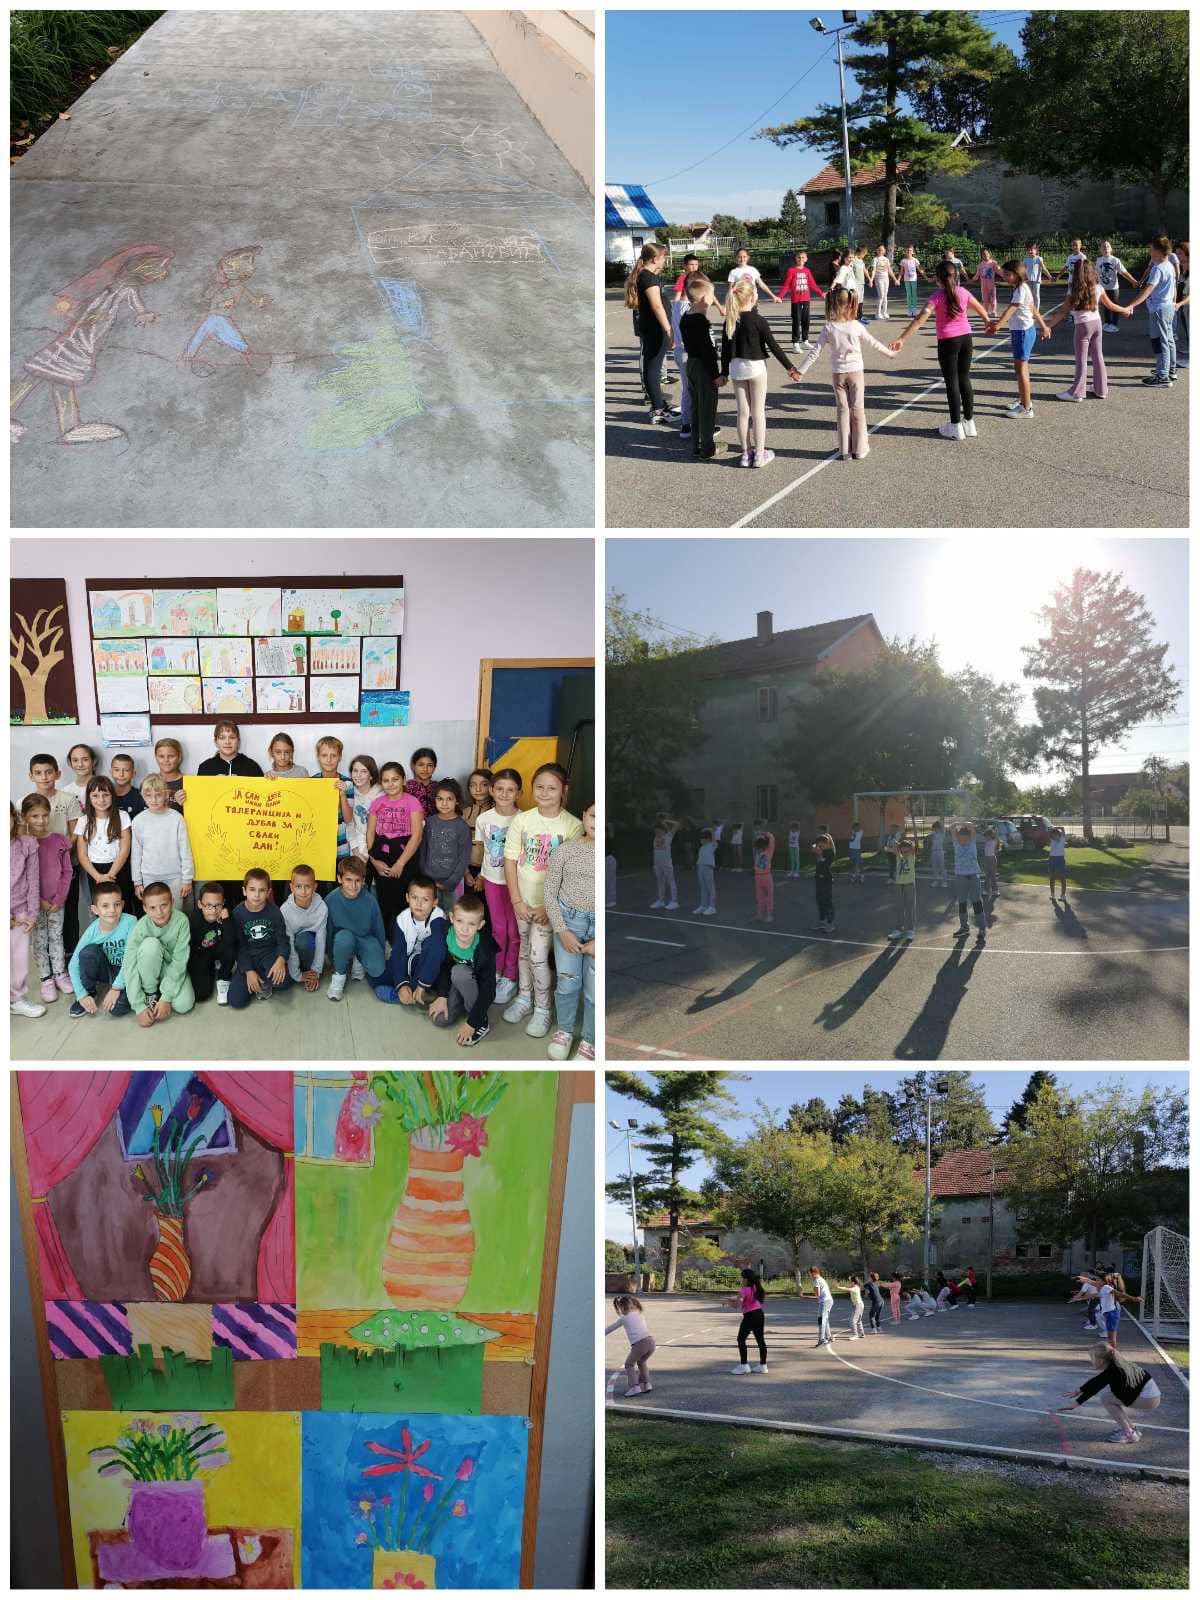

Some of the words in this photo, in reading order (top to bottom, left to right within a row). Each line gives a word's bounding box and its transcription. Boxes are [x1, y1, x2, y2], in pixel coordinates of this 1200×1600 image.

[244, 791, 260, 801] САМ
[225, 806, 291, 817] ТОЛЕРАНЦИЈА
[247, 819, 277, 828] ЉУБАВ
[282, 821, 293, 829] ЗА
[248, 830, 280, 840] СВАКИ
